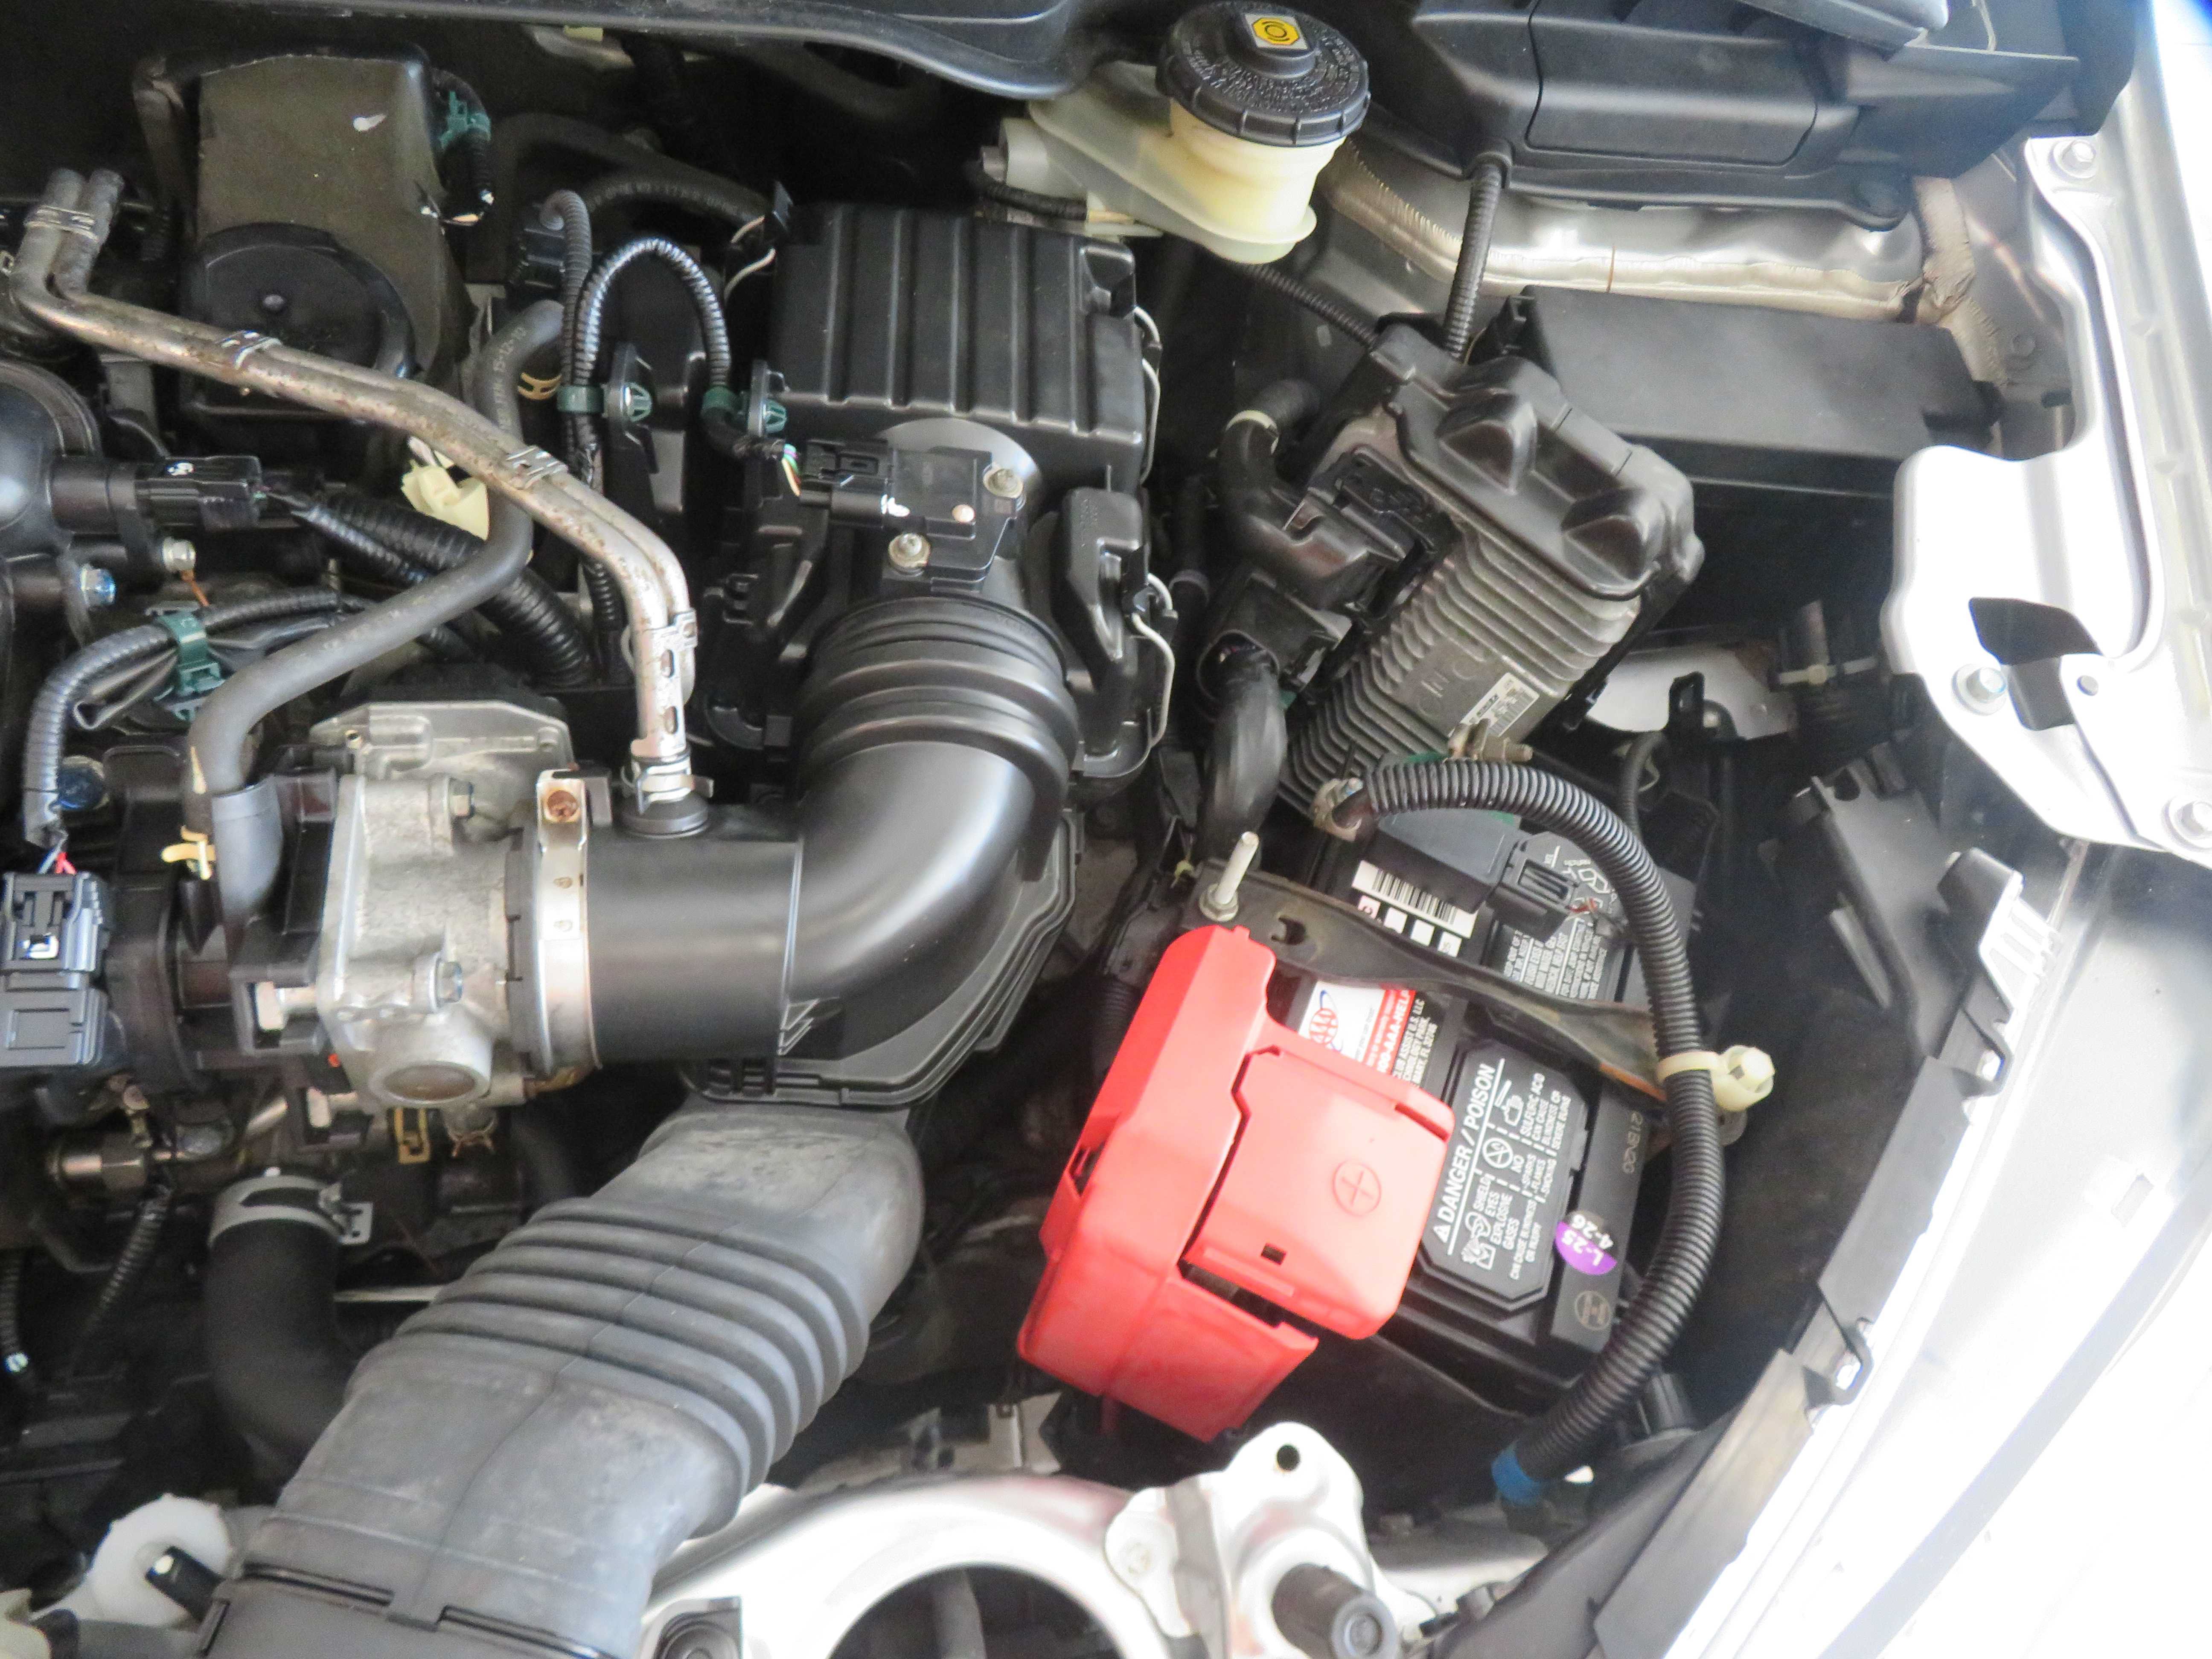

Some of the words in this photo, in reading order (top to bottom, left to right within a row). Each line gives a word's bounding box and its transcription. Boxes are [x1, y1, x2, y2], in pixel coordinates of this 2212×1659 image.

[1519, 1094, 1540, 1137] SULFURIC
[1530, 1073, 1545, 1095] ACID
[1535, 1099, 1549, 1124] CAUSE
[1551, 1090, 1561, 1104] OR
[1557, 1095, 1571, 1122] BURNS
[1531, 1123, 1543, 1141] CAN
[1541, 1102, 1562, 1146] BLINDNESS
[1551, 1121, 1565, 1150] SEVERE
[1438, 1144, 1473, 1223] DANGER
[1463, 1063, 1496, 1131] POISON
[1511, 1154, 1525, 1173] NO
[1484, 1191, 1500, 1217] EYES
[1490, 1193, 1513, 1245] EXPLOSIVE
[1502, 1217, 1520, 1250] GASES
[1519, 1199, 1537, 1239] BLINDNESS
[1571, 1214, 1614, 1250] 4-26
[1513, 1238, 1528, 1263] CAUSE
[1561, 1229, 1603, 1267] L-25
[1510, 1260, 1522, 1280] CAN
